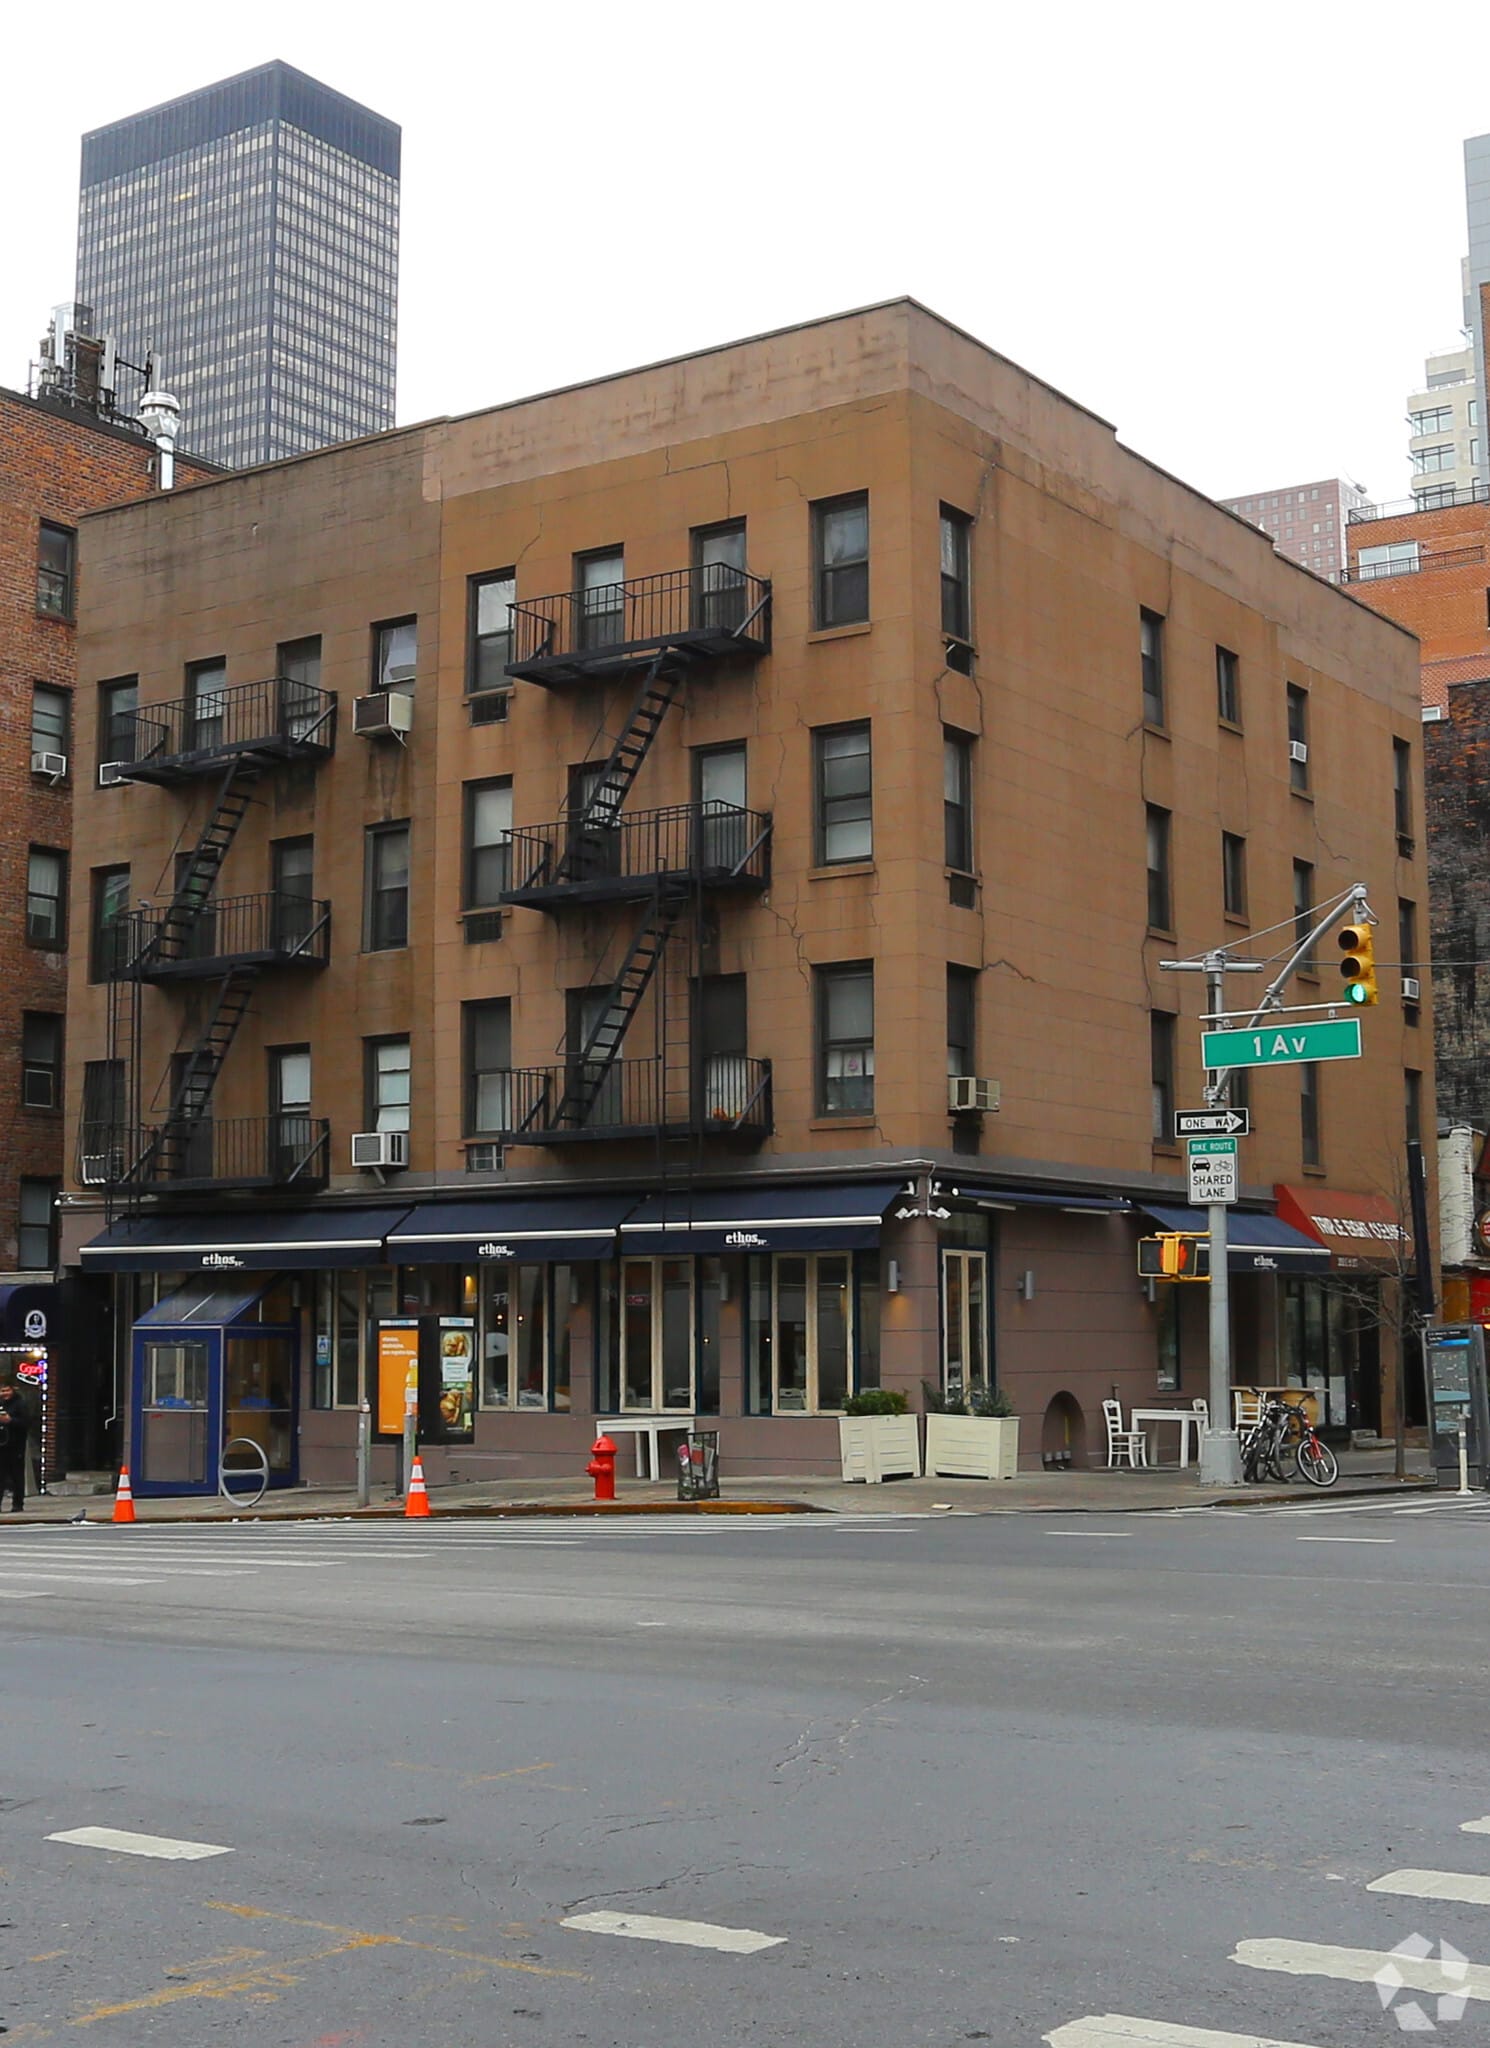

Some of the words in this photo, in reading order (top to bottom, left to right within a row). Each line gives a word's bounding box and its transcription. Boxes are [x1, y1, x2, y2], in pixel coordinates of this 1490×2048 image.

[1253, 1036, 1261, 1056] 1
[1271, 1034, 1306, 1055] Av
[1186, 1119, 1206, 1128] ONE
[1215, 1118, 1236, 1127] WAY
[1191, 1143, 1207, 1152] BIKE
[1210, 1141, 1233, 1151] ROUTE
[1192, 1175, 1233, 1186] SHARED
[1199, 1188, 1226, 1199] LANE
[725, 1231, 758, 1244] ethos
[478, 1242, 507, 1255] ethos
[202, 1253, 236, 1265] ethos
